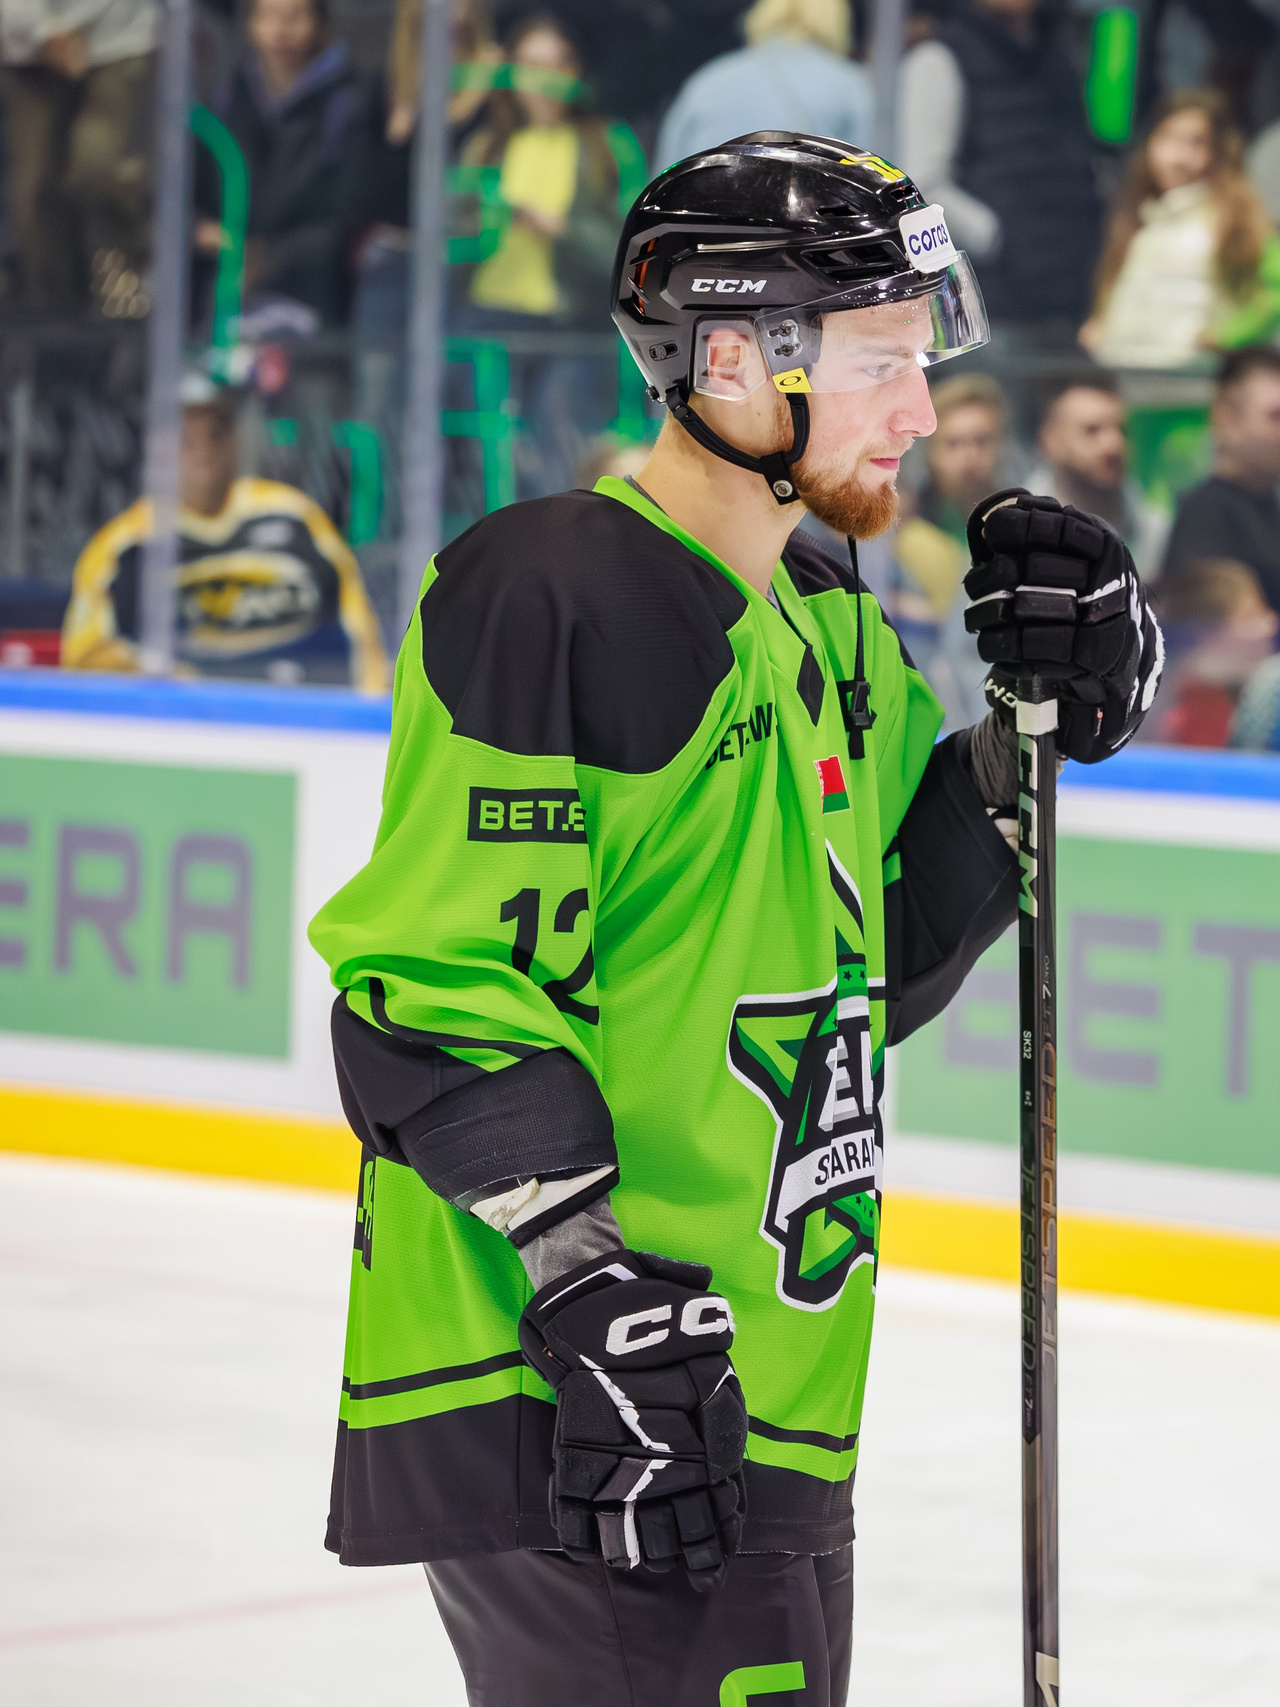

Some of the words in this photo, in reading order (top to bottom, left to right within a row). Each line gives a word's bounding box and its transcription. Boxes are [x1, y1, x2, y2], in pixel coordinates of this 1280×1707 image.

[691, 278, 768, 294] CCM
[500, 887, 600, 1027] 12
[1022, 1030, 1032, 1060] SK32
[815, 1136, 876, 1186] SARA
